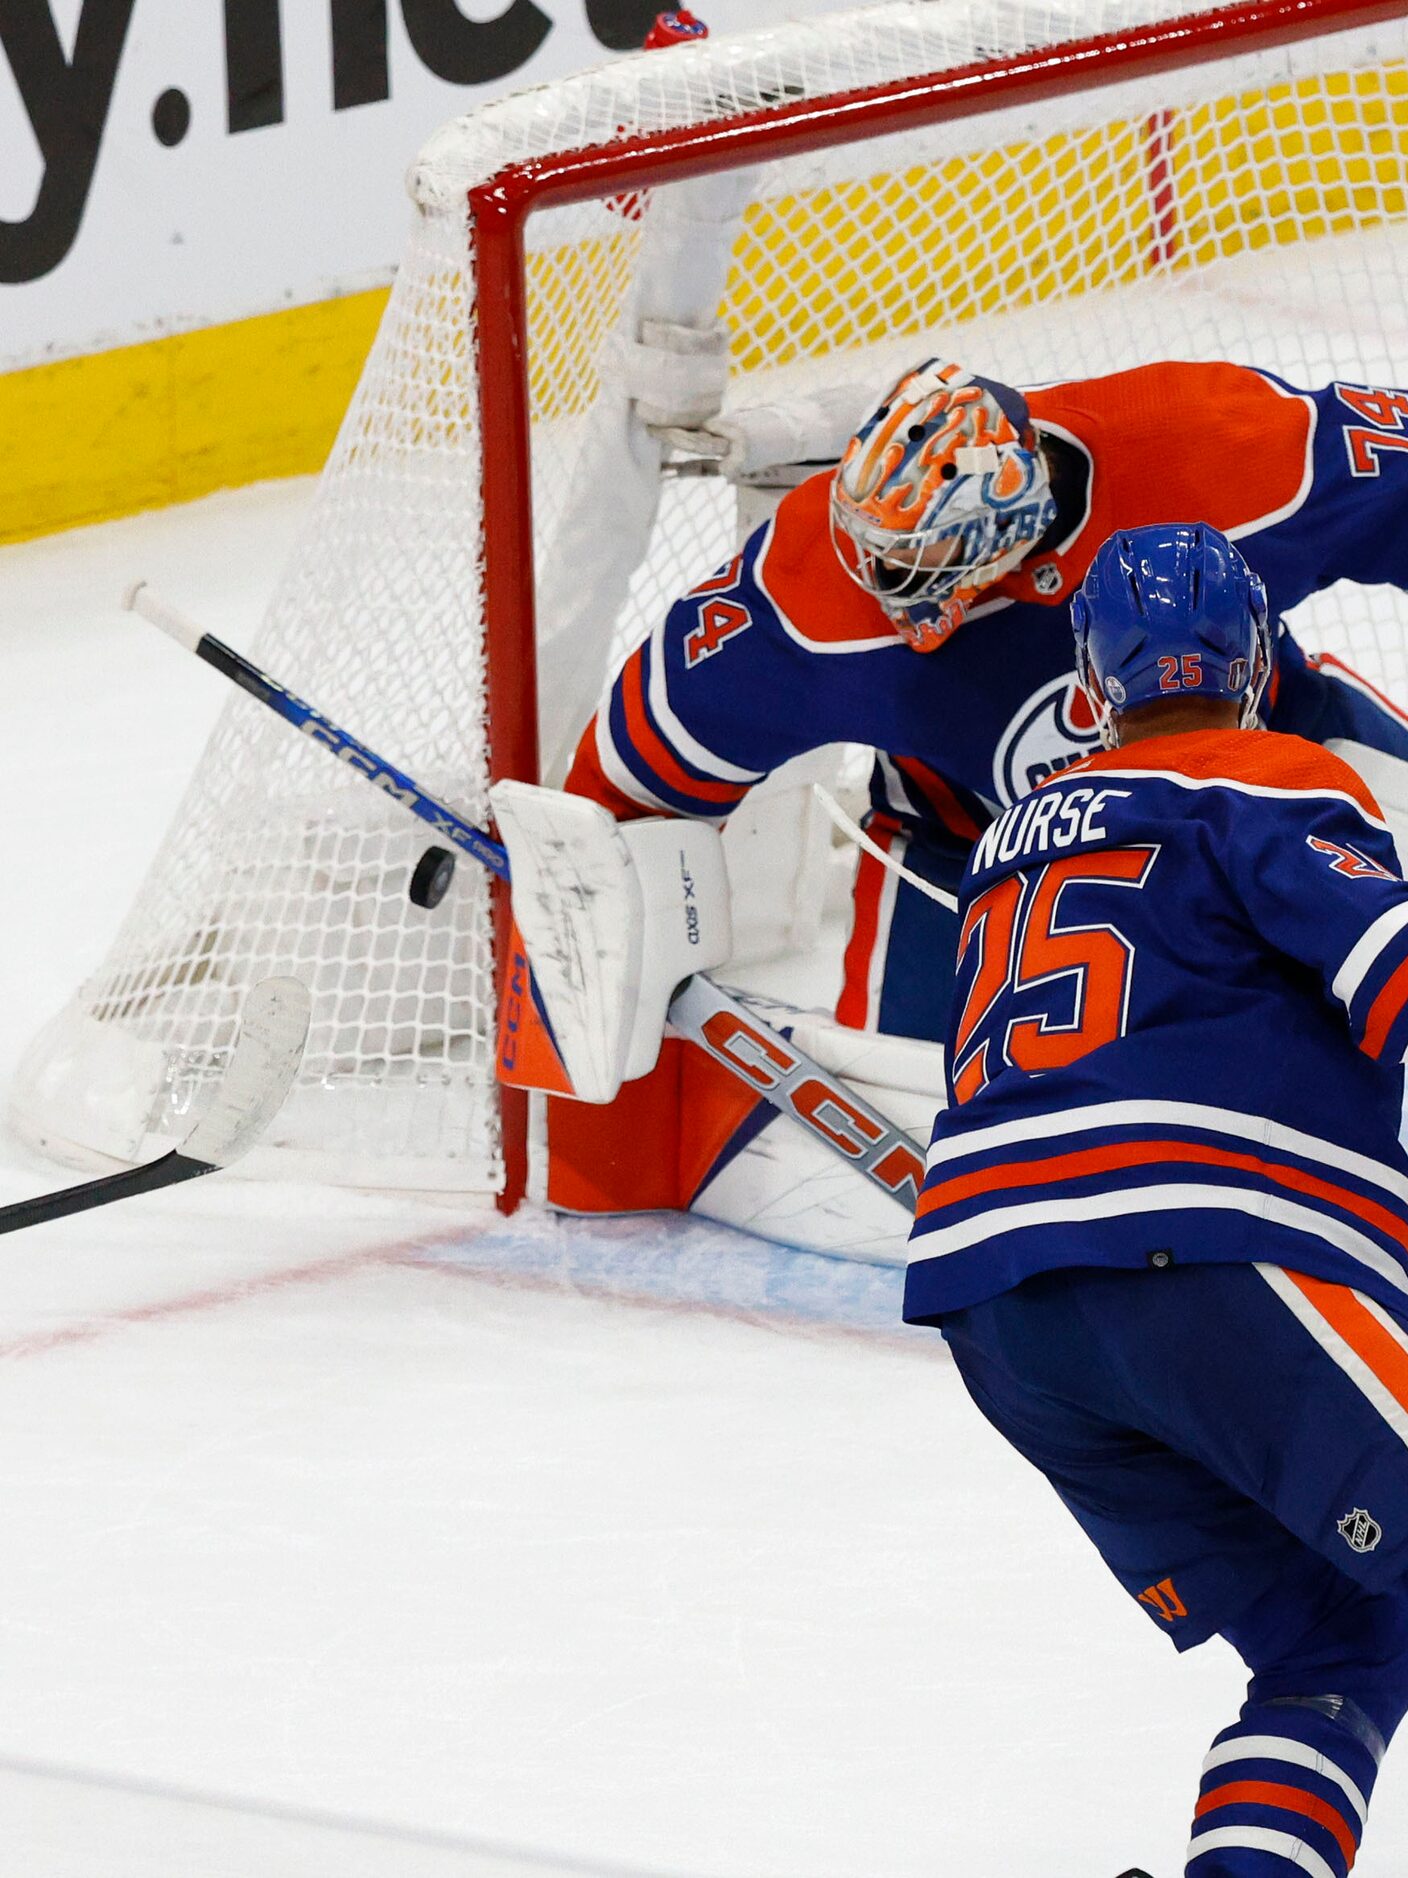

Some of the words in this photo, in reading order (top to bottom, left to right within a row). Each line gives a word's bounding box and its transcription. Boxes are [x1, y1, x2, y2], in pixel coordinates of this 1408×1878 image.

[1158, 653, 1203, 691] 25
[300, 719, 420, 809] CCM
[971, 787, 1132, 876] NURSE
[1304, 834, 1403, 882] 2
[503, 952, 526, 1071] CCM
[953, 841, 1158, 1108] 25
